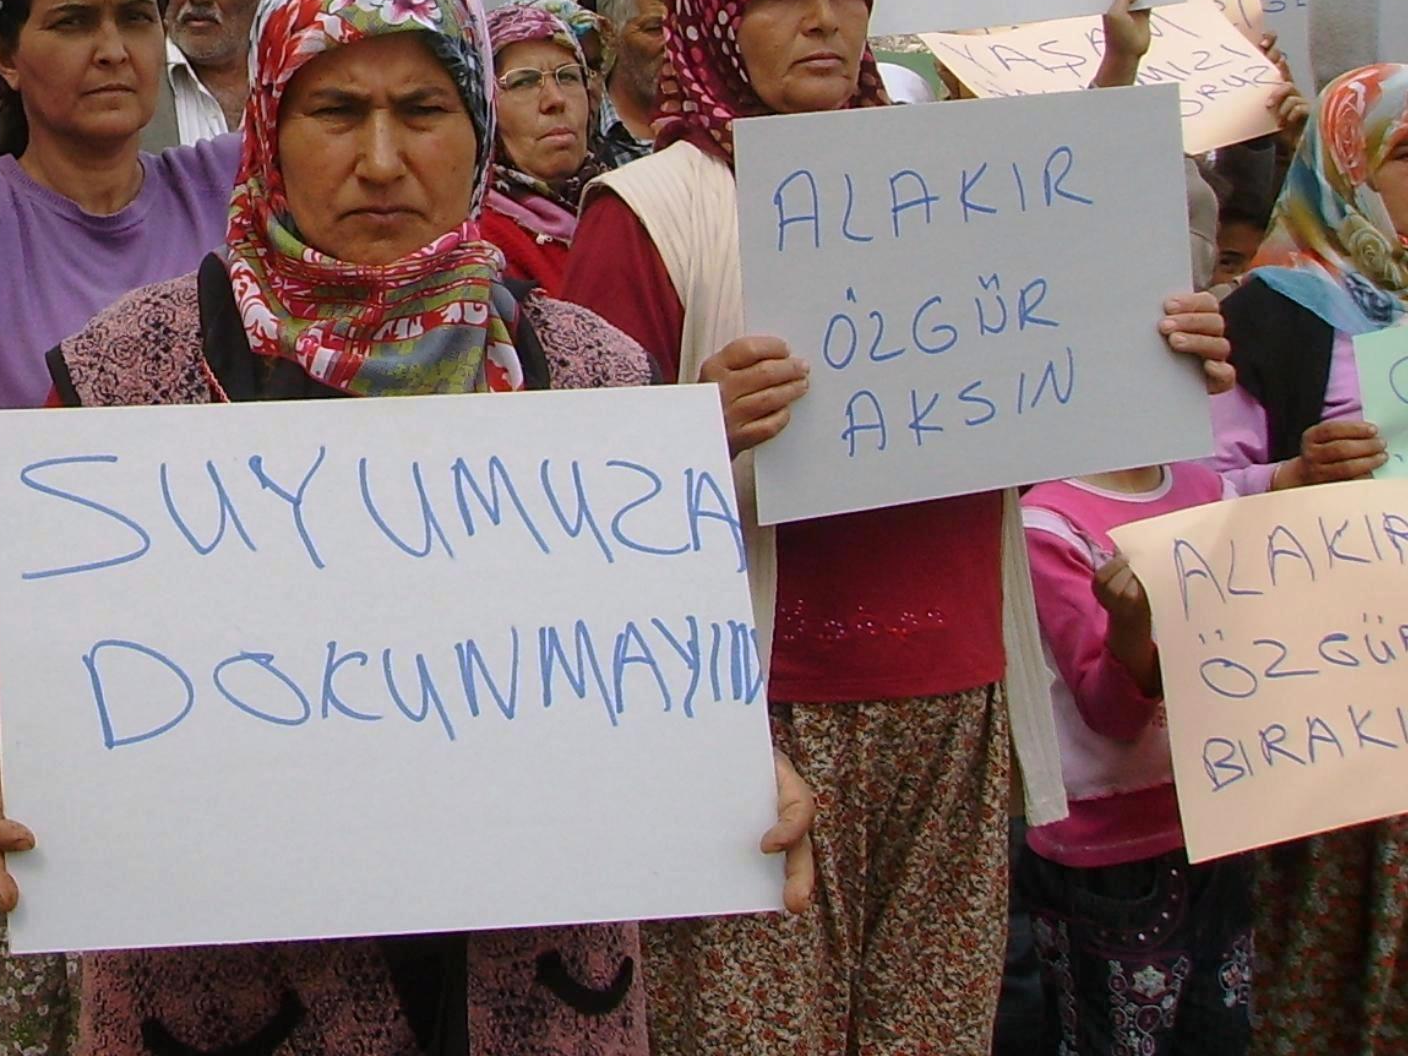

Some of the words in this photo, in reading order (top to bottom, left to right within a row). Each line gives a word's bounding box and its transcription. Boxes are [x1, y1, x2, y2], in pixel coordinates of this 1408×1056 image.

[772, 145, 1093, 251] ALAKIR
[822, 273, 1060, 370] ÖZGÜR
[841, 347, 1075, 458] AKSIN
[21, 446, 749, 580] SUYUMUZA
[82, 615, 765, 749] DOKUNMAYIN
